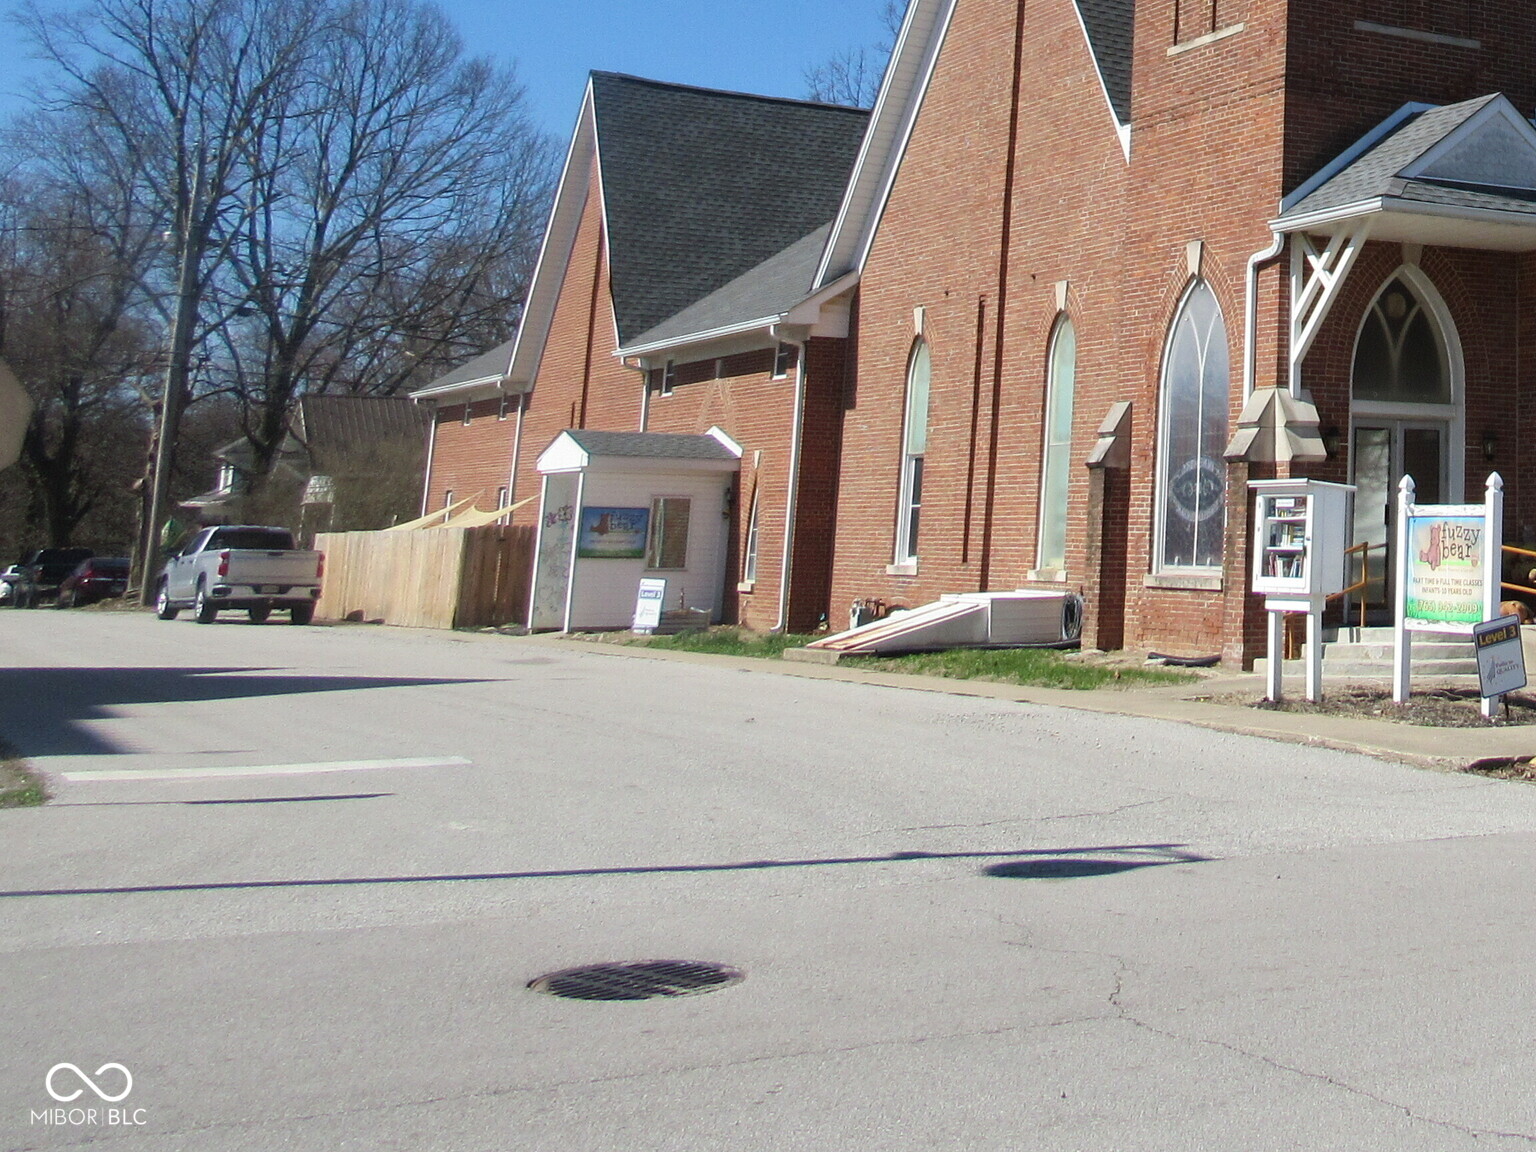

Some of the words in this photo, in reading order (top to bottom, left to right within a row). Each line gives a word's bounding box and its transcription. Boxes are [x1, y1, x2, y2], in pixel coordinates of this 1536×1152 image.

[1441, 521, 1480, 545] fuzzy
[1441, 540, 1472, 560] bear
[1463, 579, 1483, 587] CLASSES
[1479, 627, 1507, 645] Level
[1510, 625, 1517, 638] 3
